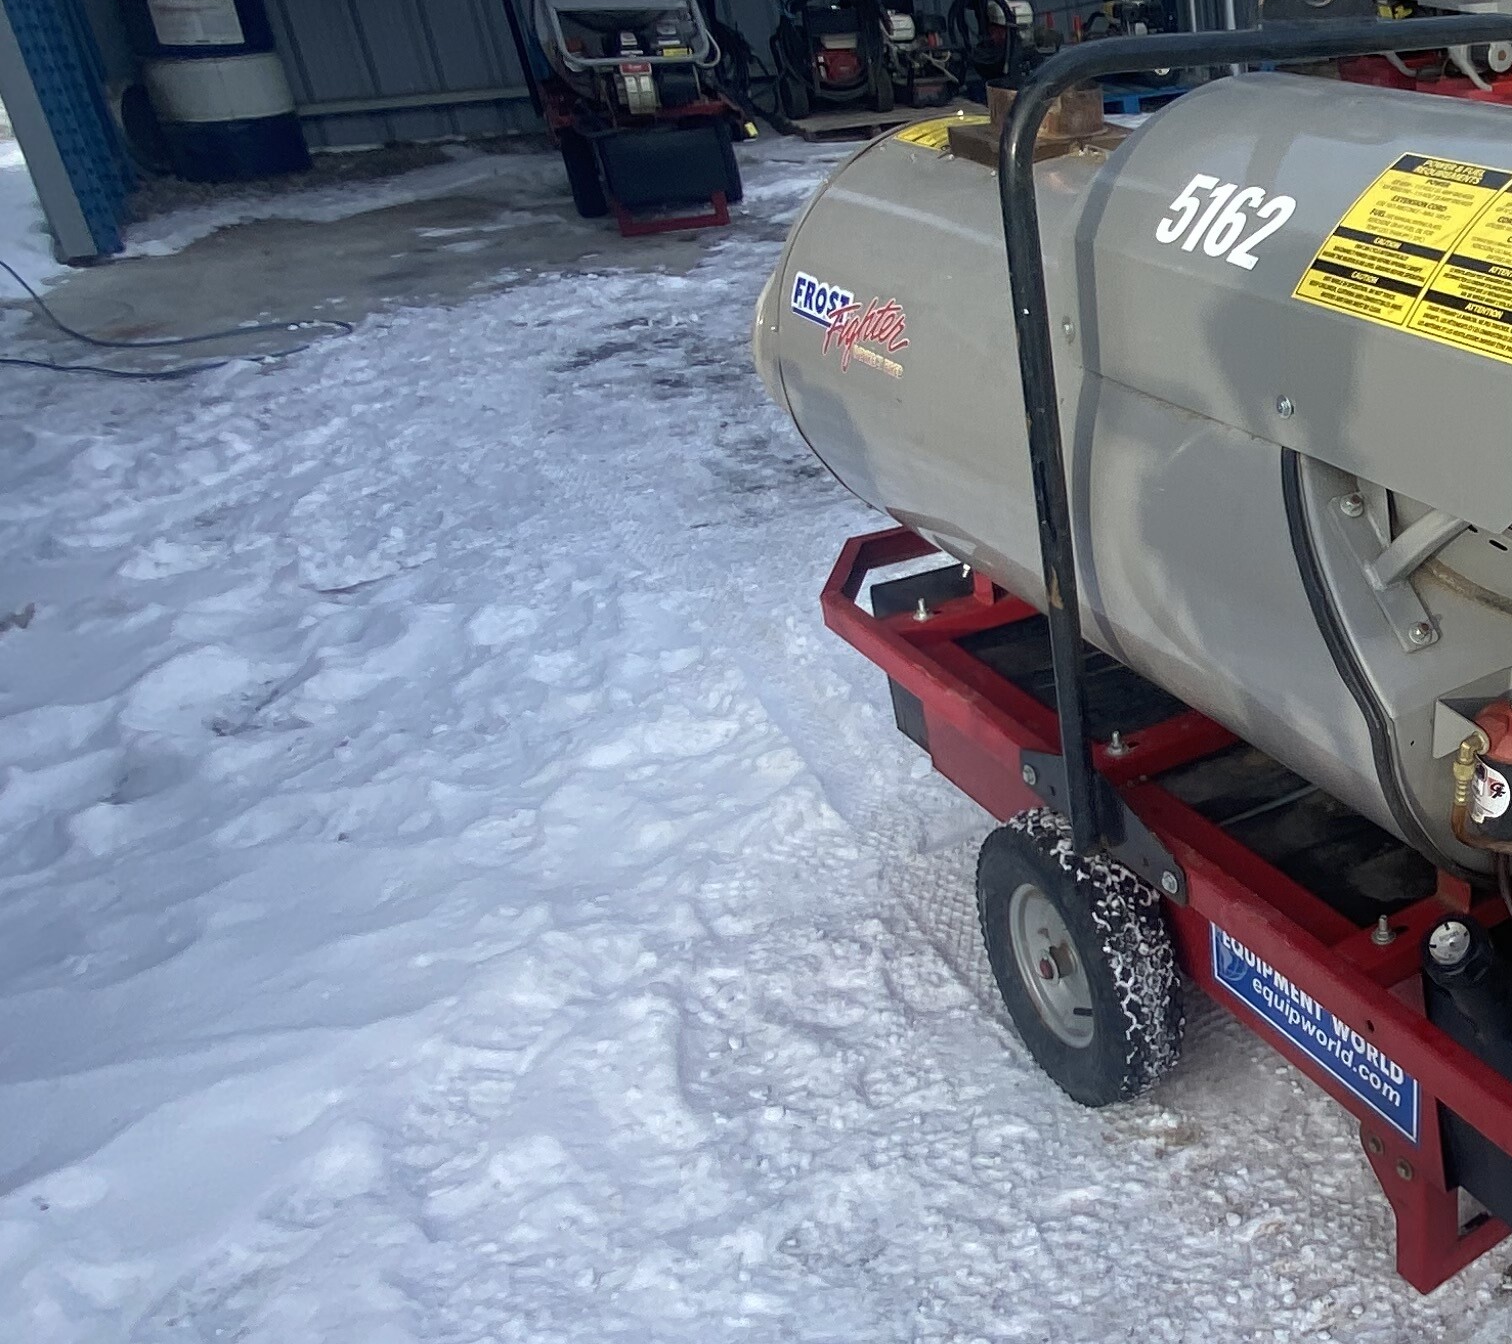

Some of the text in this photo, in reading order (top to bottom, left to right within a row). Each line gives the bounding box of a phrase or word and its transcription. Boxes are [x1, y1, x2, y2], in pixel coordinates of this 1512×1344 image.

[1155, 173, 1297, 271] 5162
[1391, 195, 1447, 212] EXTENSION CORD
[1373, 236, 1402, 249] CAUTION
[793, 276, 850, 323] FROST
[1351, 271, 1379, 284] CAUTION
[1465, 303, 1503, 319] ATTENTION
[823, 297, 909, 373] Fighter
[1222, 930, 1404, 1085] EQUIPMENT WORLD
[1253, 978, 1401, 1107] equipworld.com
